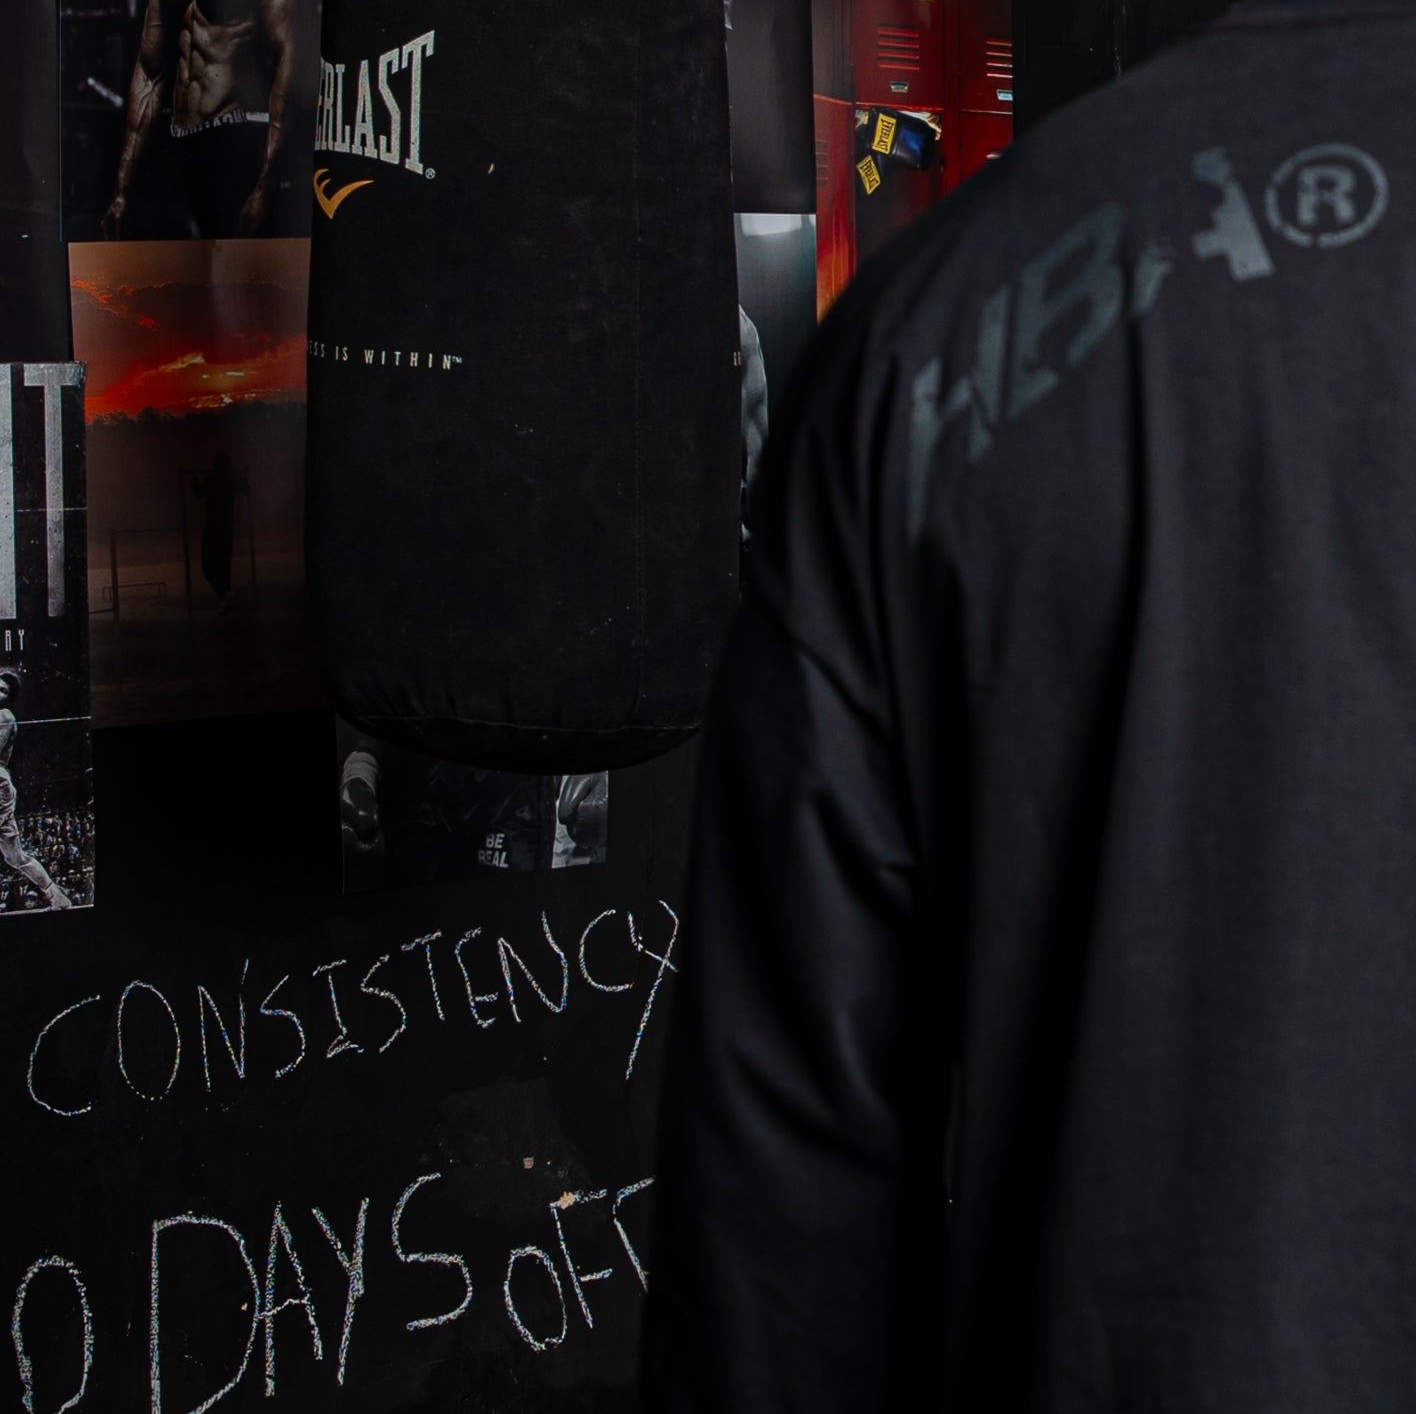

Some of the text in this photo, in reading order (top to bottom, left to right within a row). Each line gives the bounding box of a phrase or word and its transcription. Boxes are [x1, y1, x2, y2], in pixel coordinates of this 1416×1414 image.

[334, 346, 349, 362] IS
[485, 832, 505, 849] BE
[477, 850, 509, 868] REAL
[26, 900, 680, 1116] CONSISTENCY
